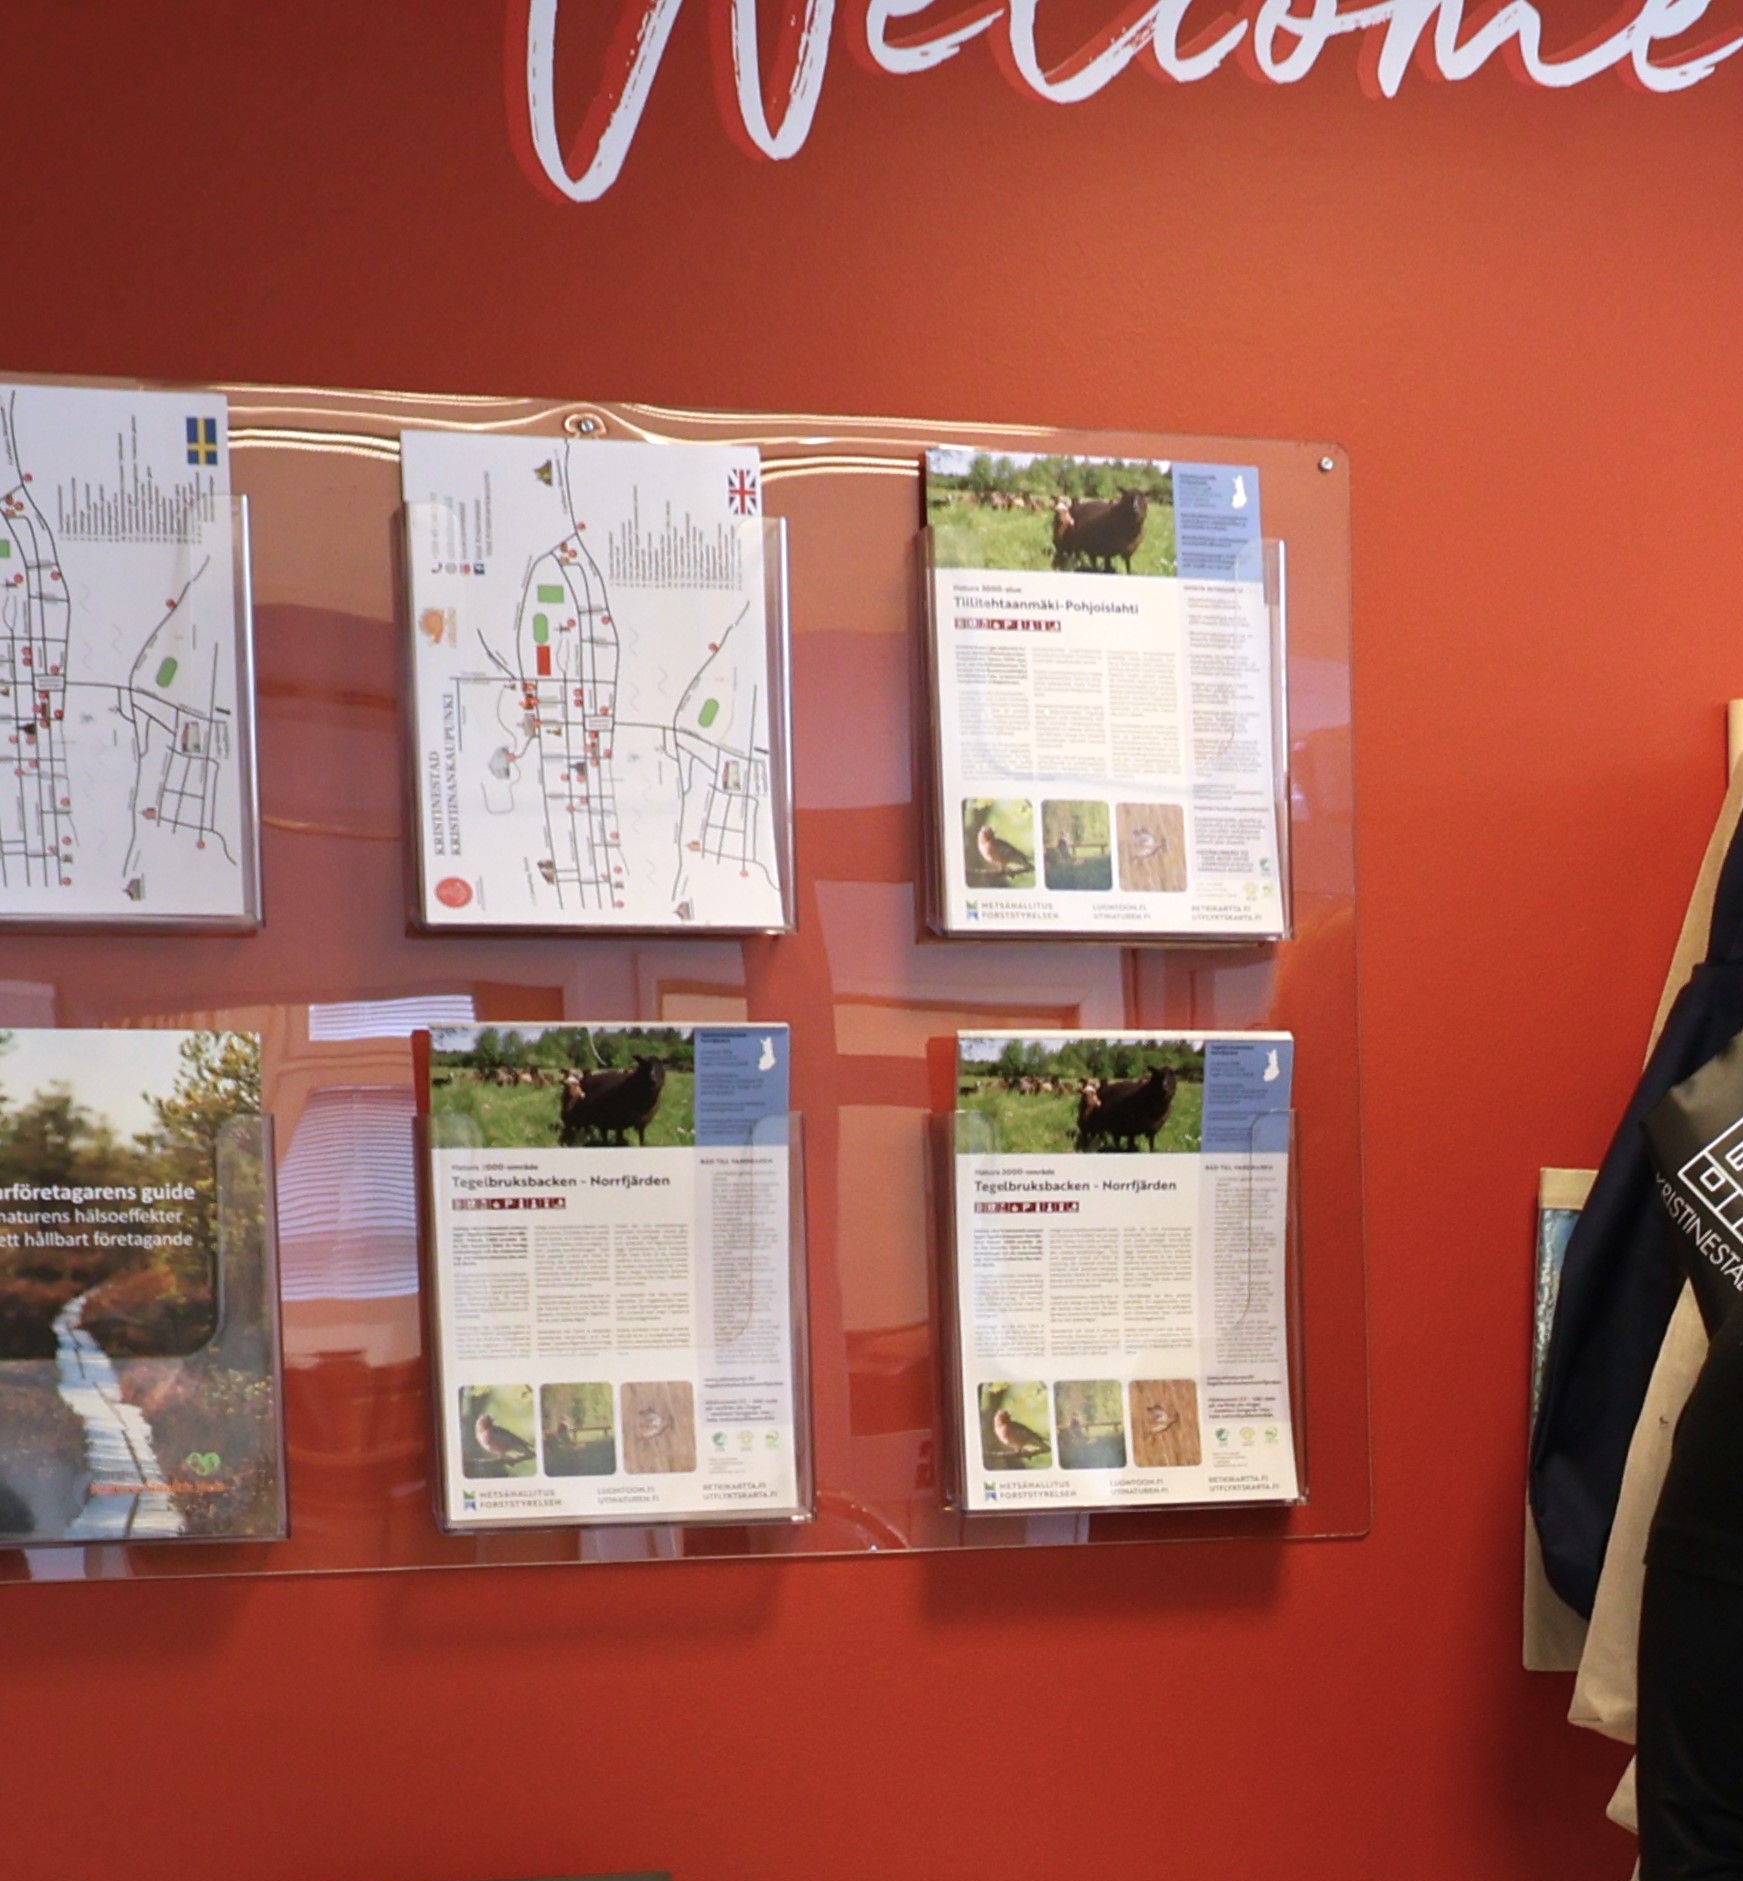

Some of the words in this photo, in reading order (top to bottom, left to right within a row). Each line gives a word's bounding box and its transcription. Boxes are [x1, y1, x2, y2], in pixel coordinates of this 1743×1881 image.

[954, 596, 1139, 616] Tiilitehtaanmäki-Pohjoislahti
[430, 751, 445, 855] KRISTINESTAD
[452, 1175, 577, 1190] Tegelbruksbacken
[590, 1175, 671, 1190] Norrfjärden
[974, 1180, 1091, 1195] Tegelbruksbacken
[1103, 1179, 1177, 1195] Norrfjärden
[141, 1183, 196, 1204] guide
[75, 1208, 183, 1224] hälsoeffekter
[24, 1231, 89, 1248] hållbart
[93, 1231, 194, 1250] företagande
